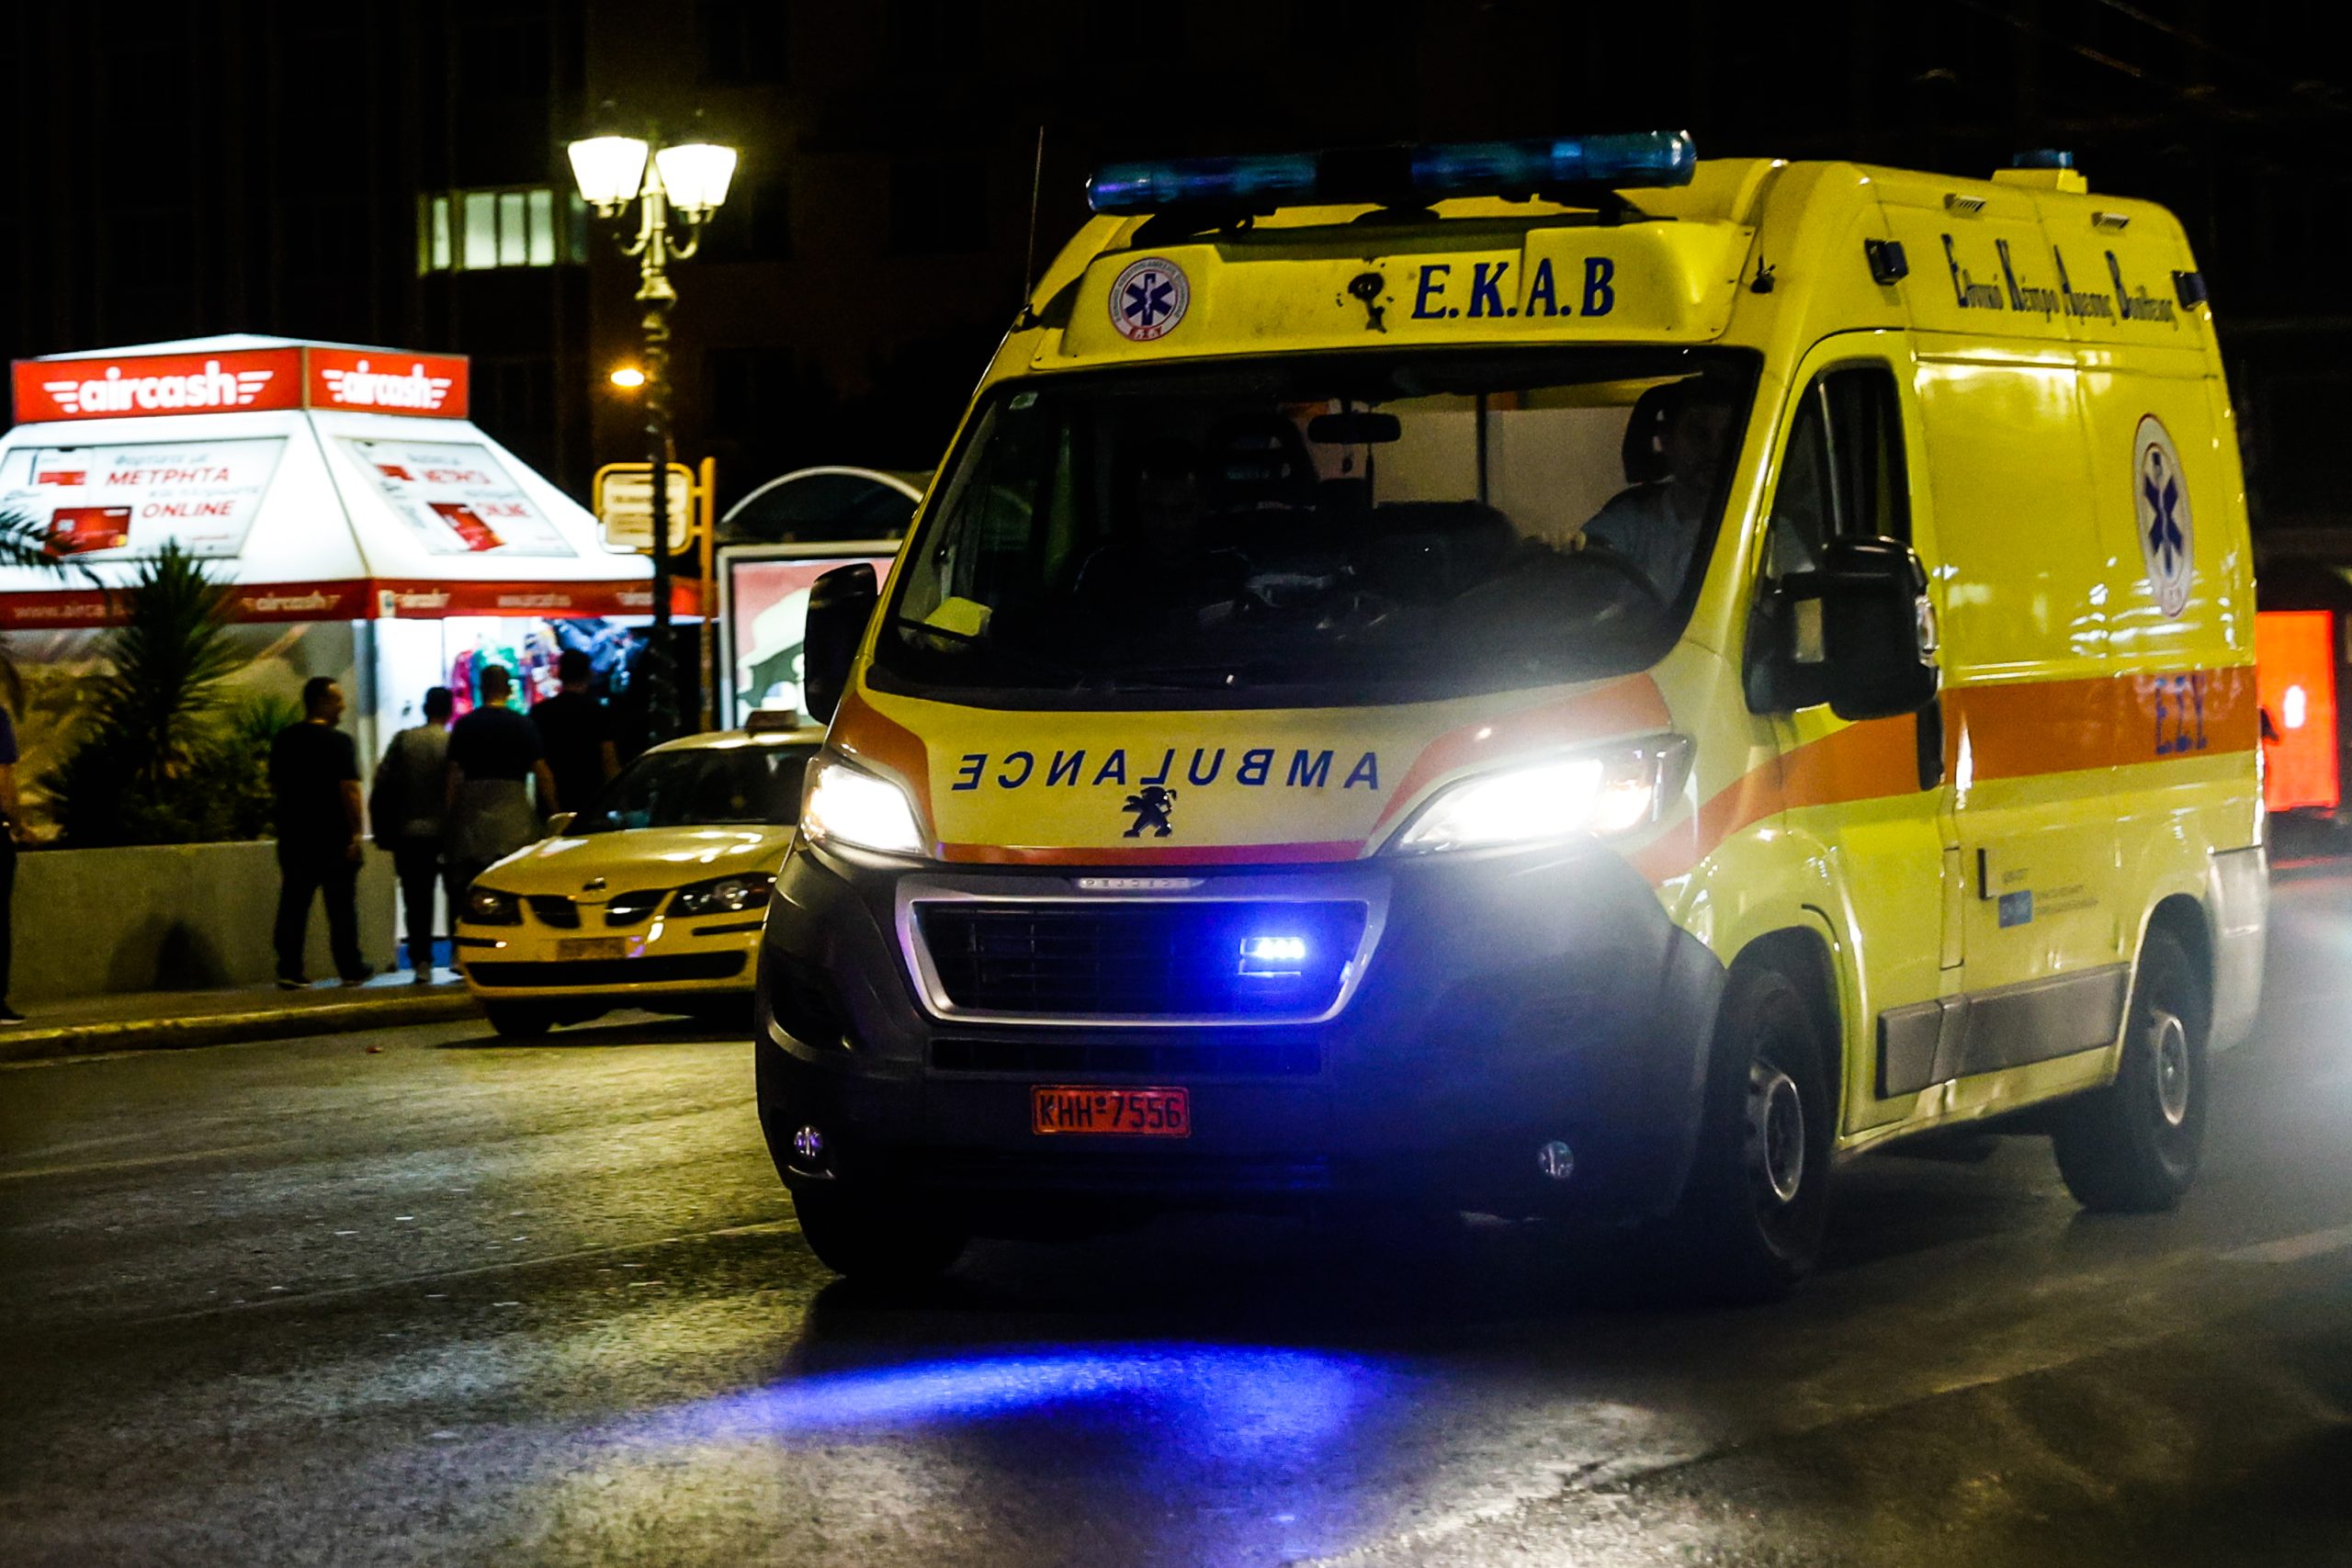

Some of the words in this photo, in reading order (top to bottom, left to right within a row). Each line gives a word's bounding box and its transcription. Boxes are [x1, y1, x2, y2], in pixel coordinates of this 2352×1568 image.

[78, 359, 238, 412] aircash
[342, 359, 433, 410] aircash
[141, 500, 236, 518] ONLINE
